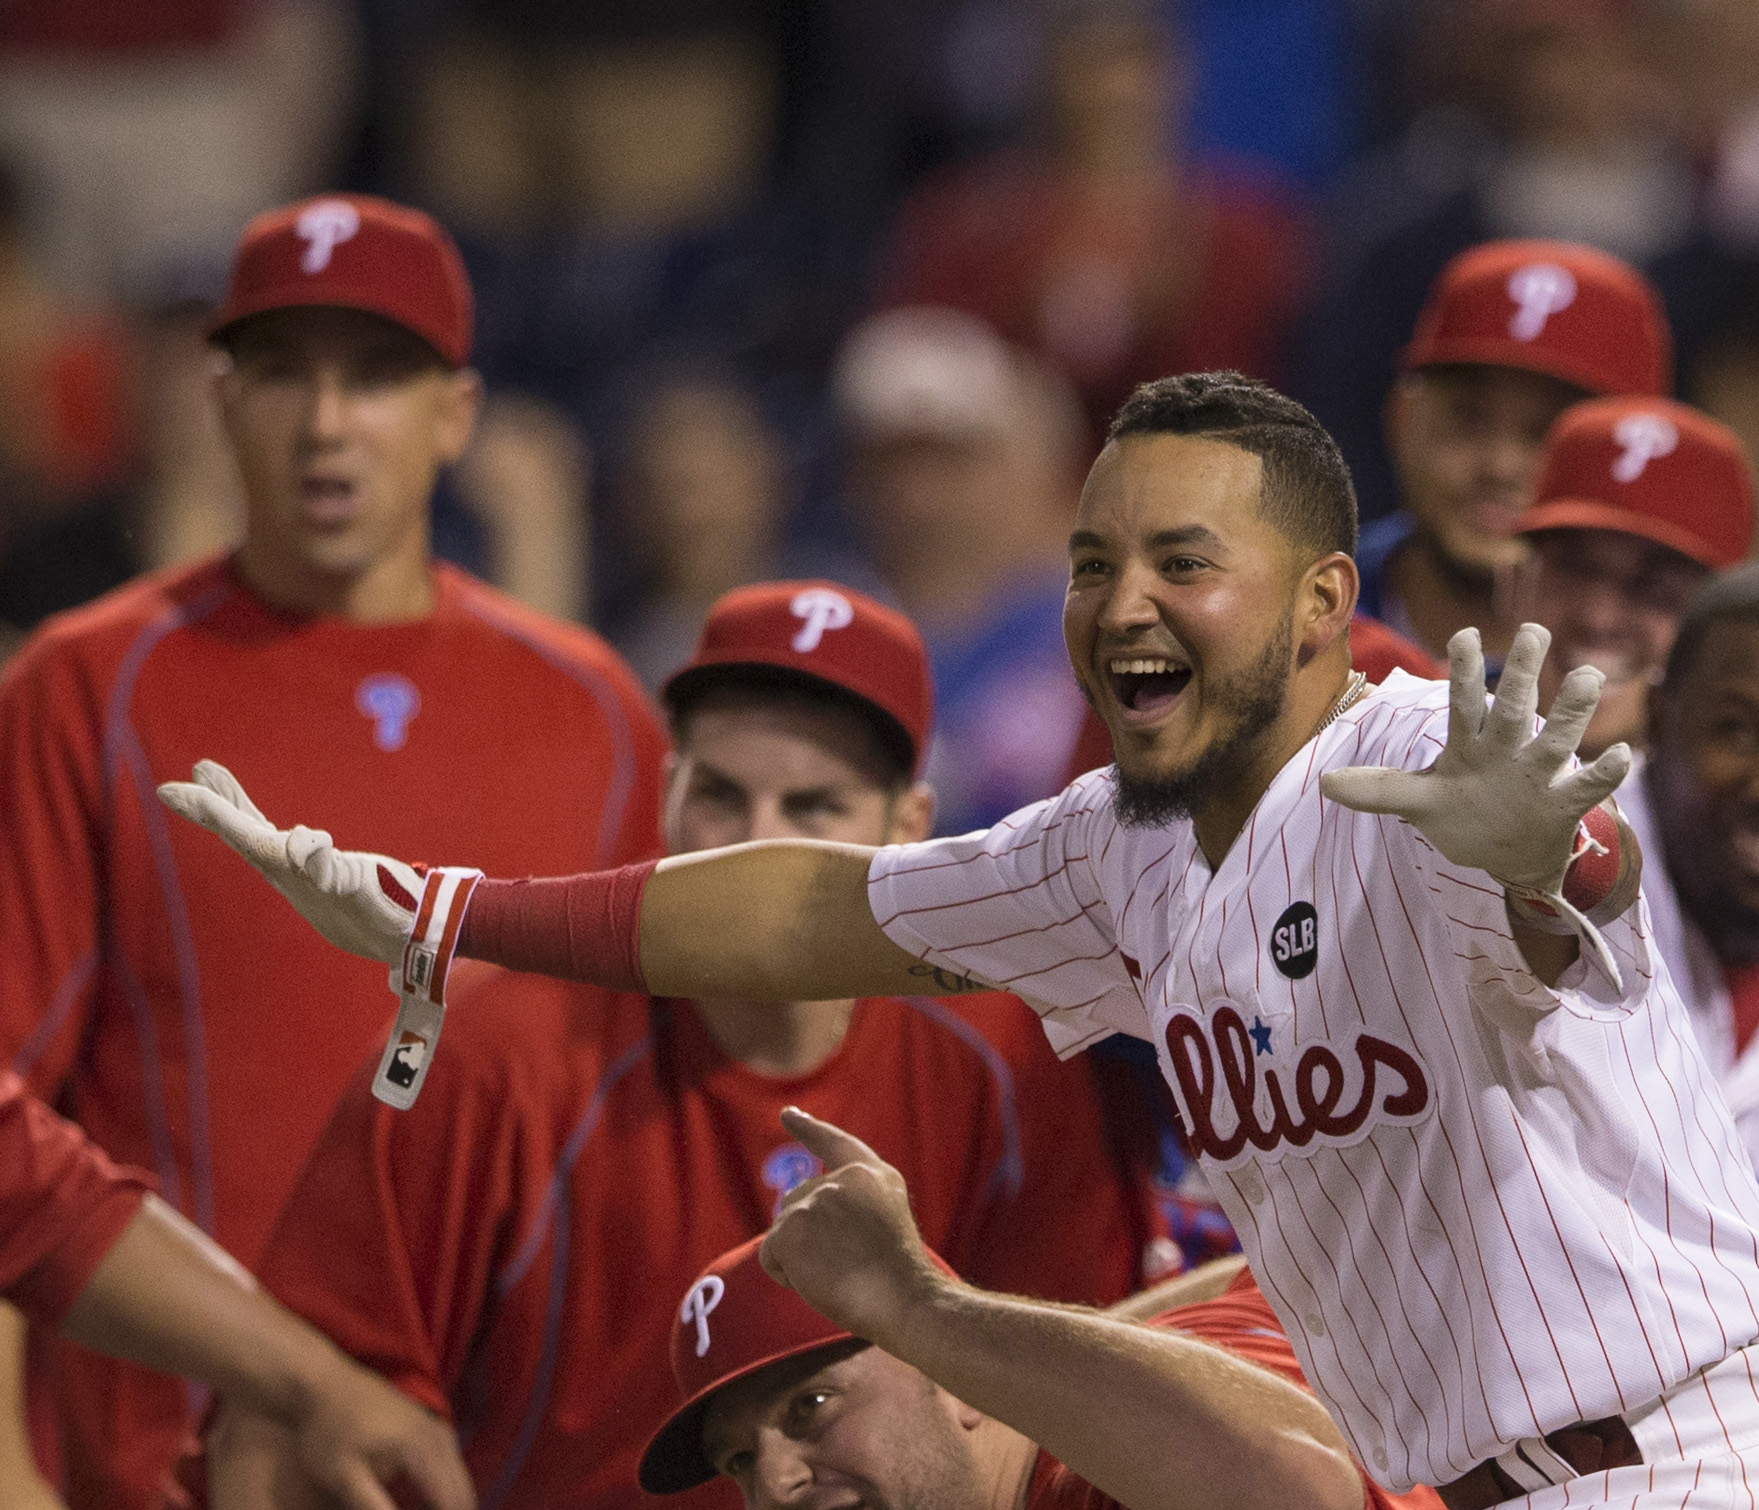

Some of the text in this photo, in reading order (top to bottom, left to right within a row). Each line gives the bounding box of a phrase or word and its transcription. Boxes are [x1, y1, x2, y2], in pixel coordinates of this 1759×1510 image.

[789, 588, 854, 654] P
[1275, 918, 1314, 961] SLB
[681, 1275, 725, 1357] P
